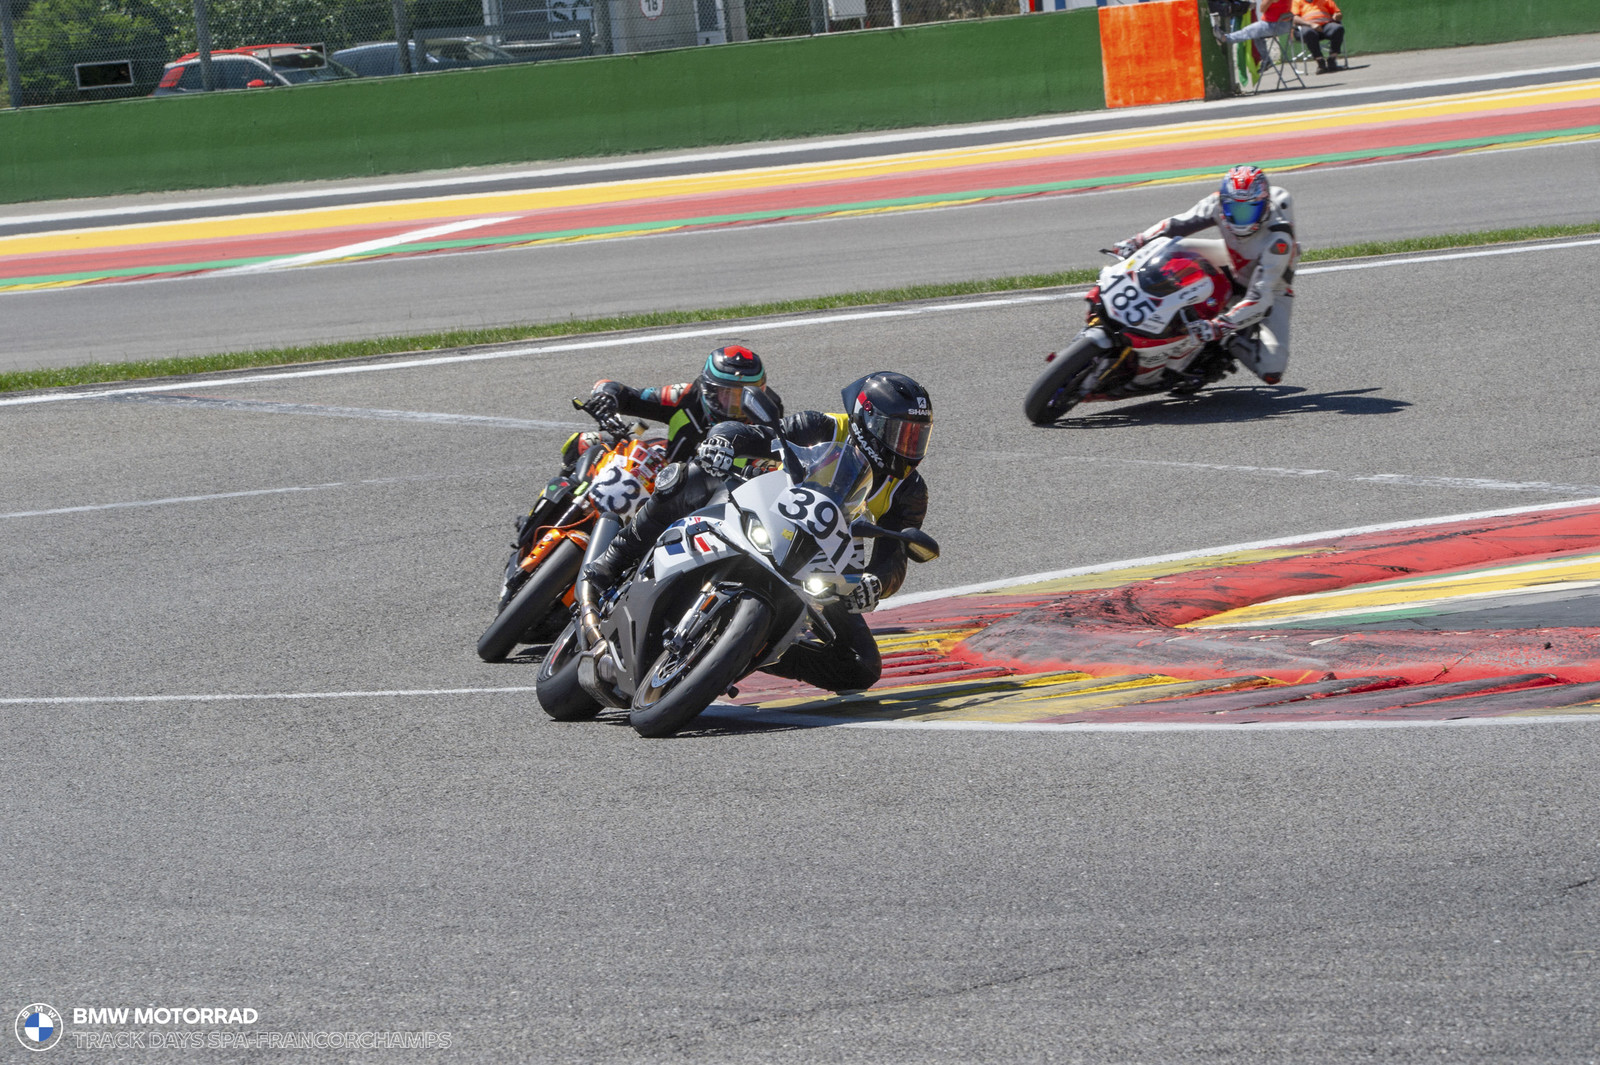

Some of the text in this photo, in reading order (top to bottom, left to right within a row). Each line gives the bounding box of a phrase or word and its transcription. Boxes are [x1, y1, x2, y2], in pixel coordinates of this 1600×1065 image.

[1101, 275, 1155, 326] 185
[851, 422, 882, 464] SHARK
[778, 488, 851, 566] 391
